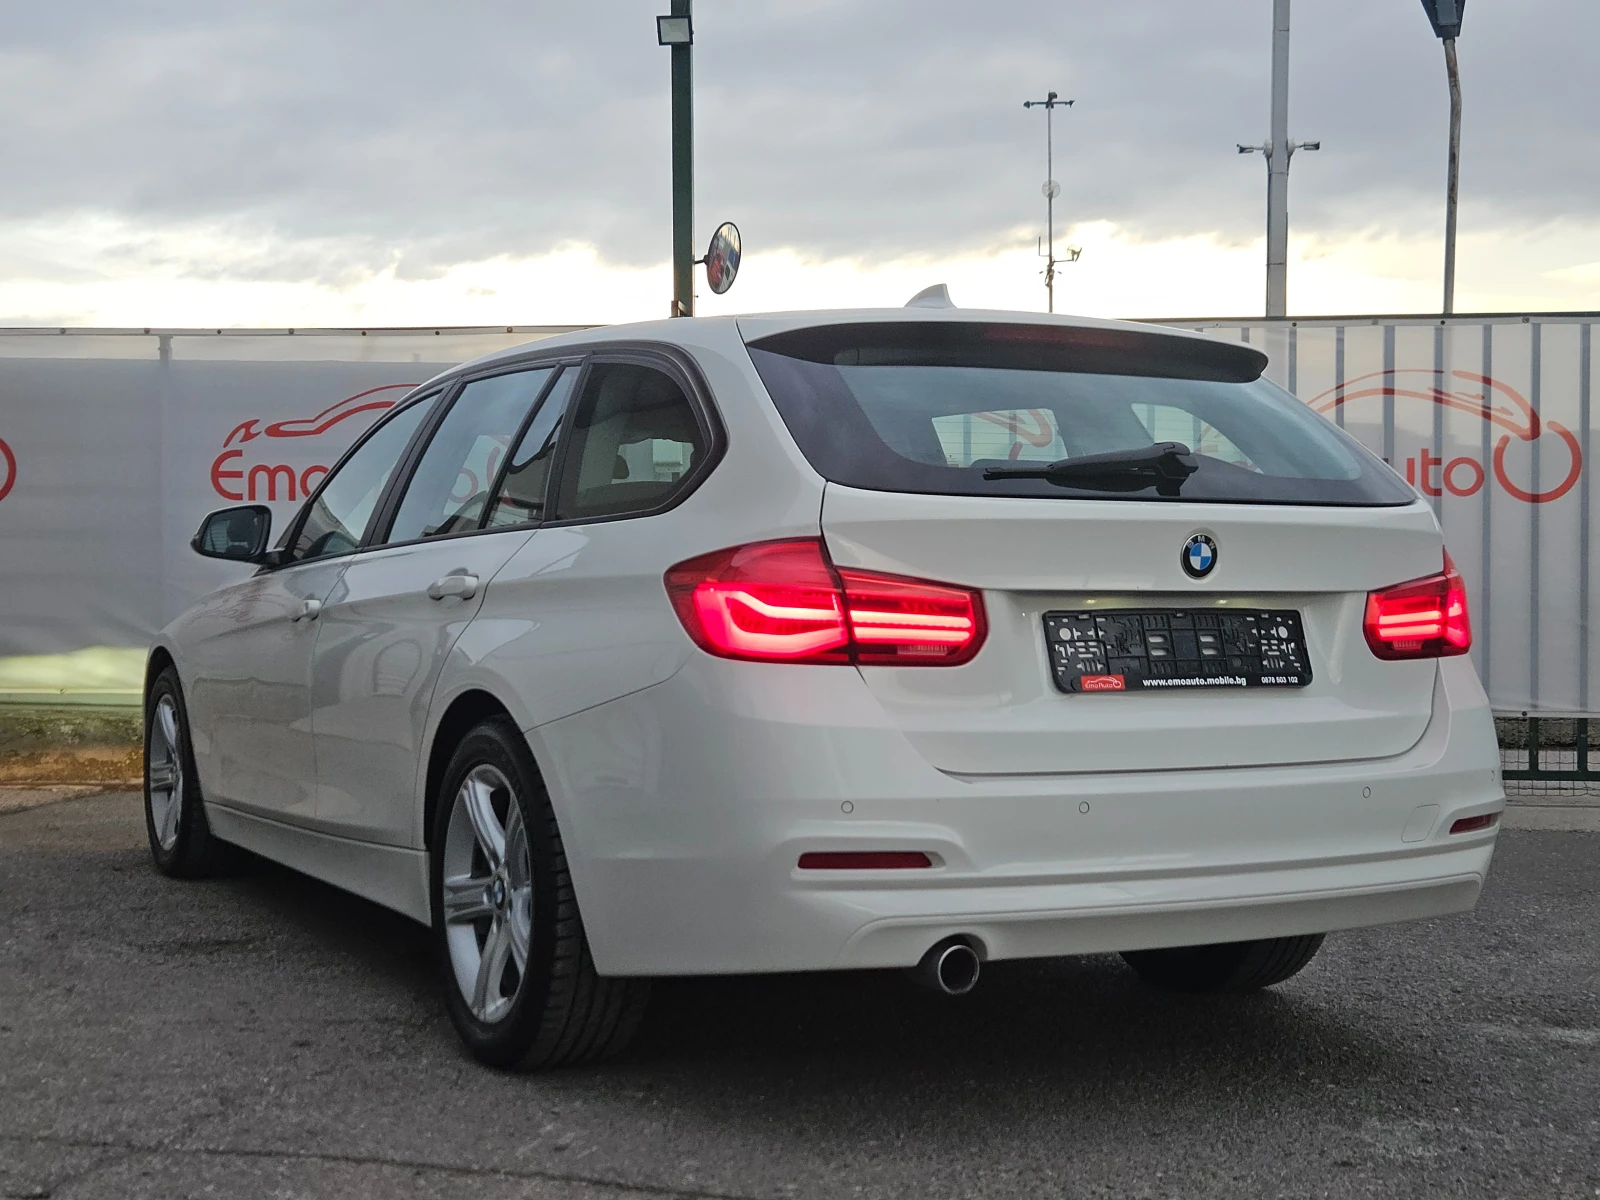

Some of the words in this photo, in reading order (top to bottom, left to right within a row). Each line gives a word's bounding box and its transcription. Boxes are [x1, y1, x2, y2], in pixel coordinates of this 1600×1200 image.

[1186, 535, 1216, 550] BMW
[1142, 676, 1247, 687] www.emoauto.mobile.bg
[1287, 676, 1298, 684] 102
